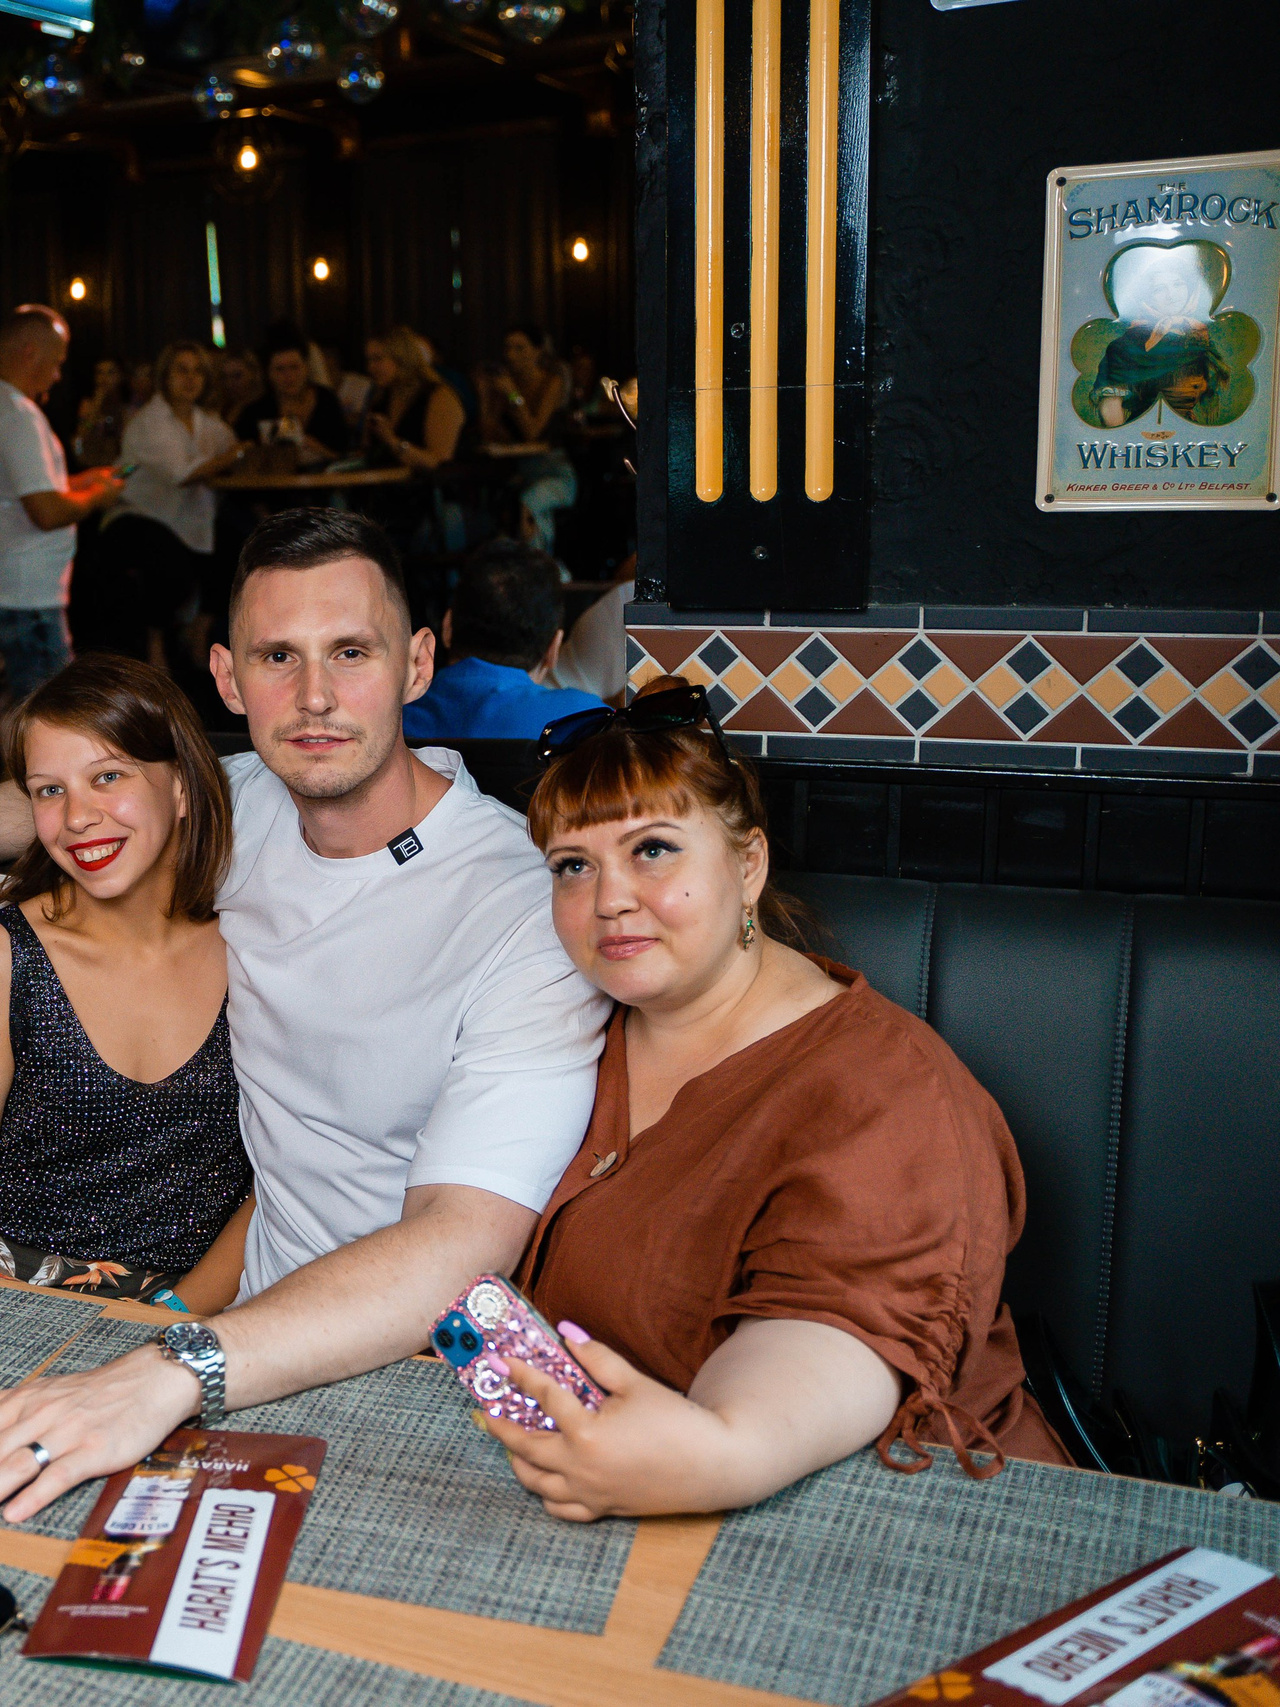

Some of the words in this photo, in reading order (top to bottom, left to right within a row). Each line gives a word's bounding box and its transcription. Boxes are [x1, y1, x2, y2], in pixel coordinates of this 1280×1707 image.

[1157, 181, 1187, 193] THE
[1068, 193, 1280, 240] SHAMROCK
[1076, 441, 1248, 470] WHISKEY
[1066, 483, 1108, 492] KIRKER
[1111, 482, 1150, 491] GREER
[201, 1502, 256, 1554] МЕНЮ
[178, 1556, 242, 1634] HARAT'S
[1022, 1627, 1128, 1683] МЕНЮ
